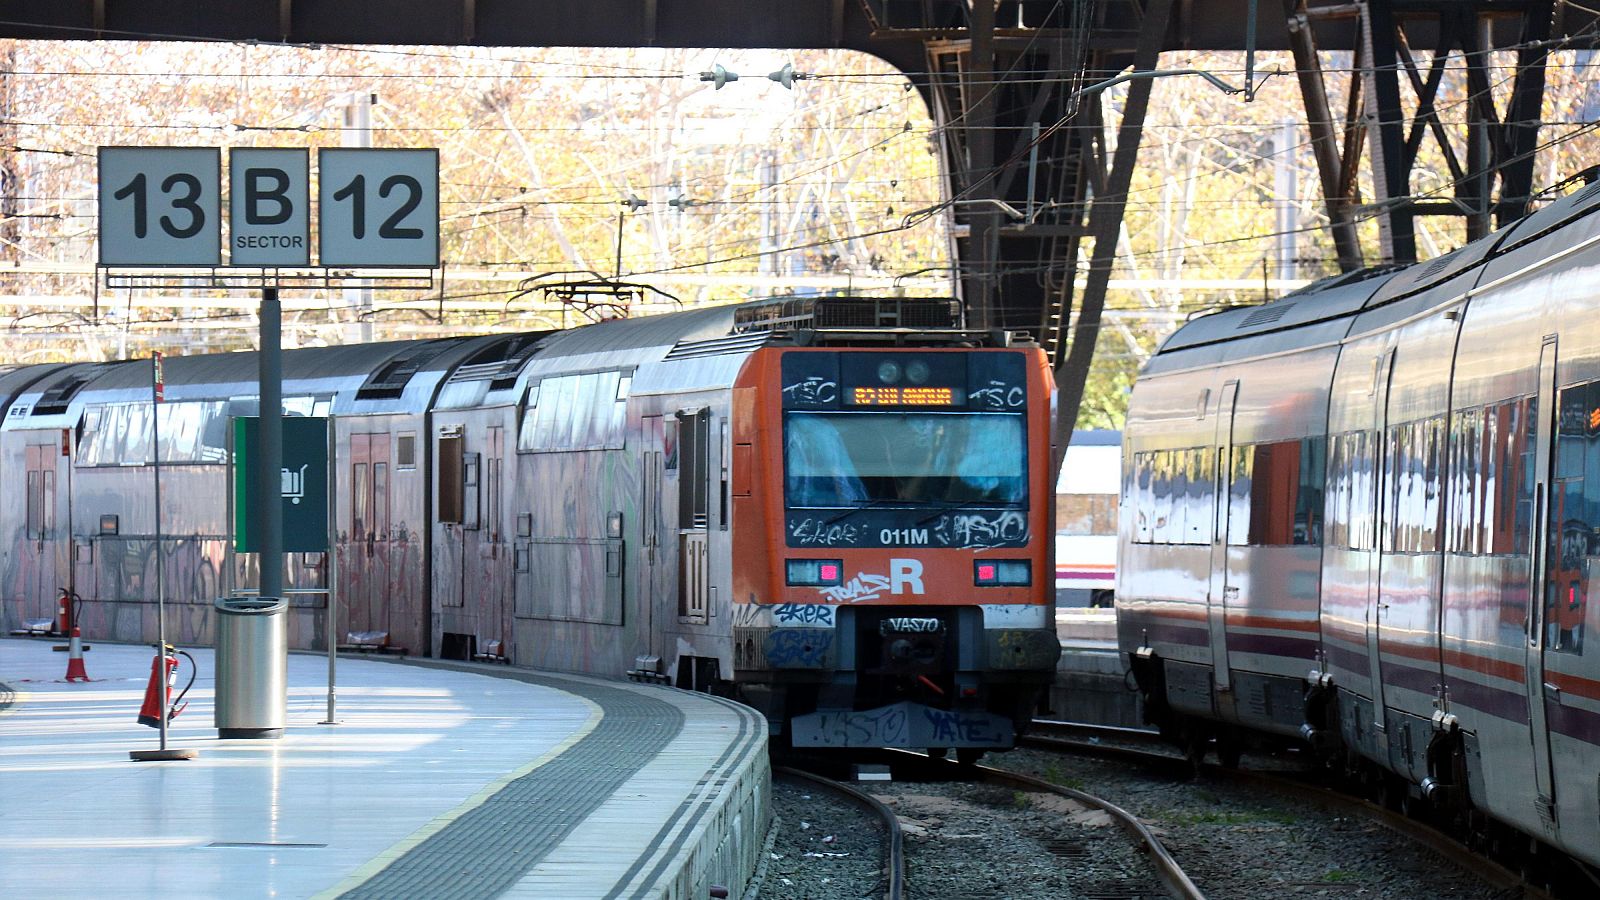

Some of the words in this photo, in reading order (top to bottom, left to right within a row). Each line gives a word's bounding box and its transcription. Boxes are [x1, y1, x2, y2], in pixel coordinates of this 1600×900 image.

[114, 172, 206, 240] 13
[245, 168, 294, 226] B
[333, 174, 424, 240] 12
[236, 236, 303, 249] SECTOR
[880, 528, 928, 545] 011M
[890, 558, 925, 594] R
[889, 617, 939, 632] VASTO
